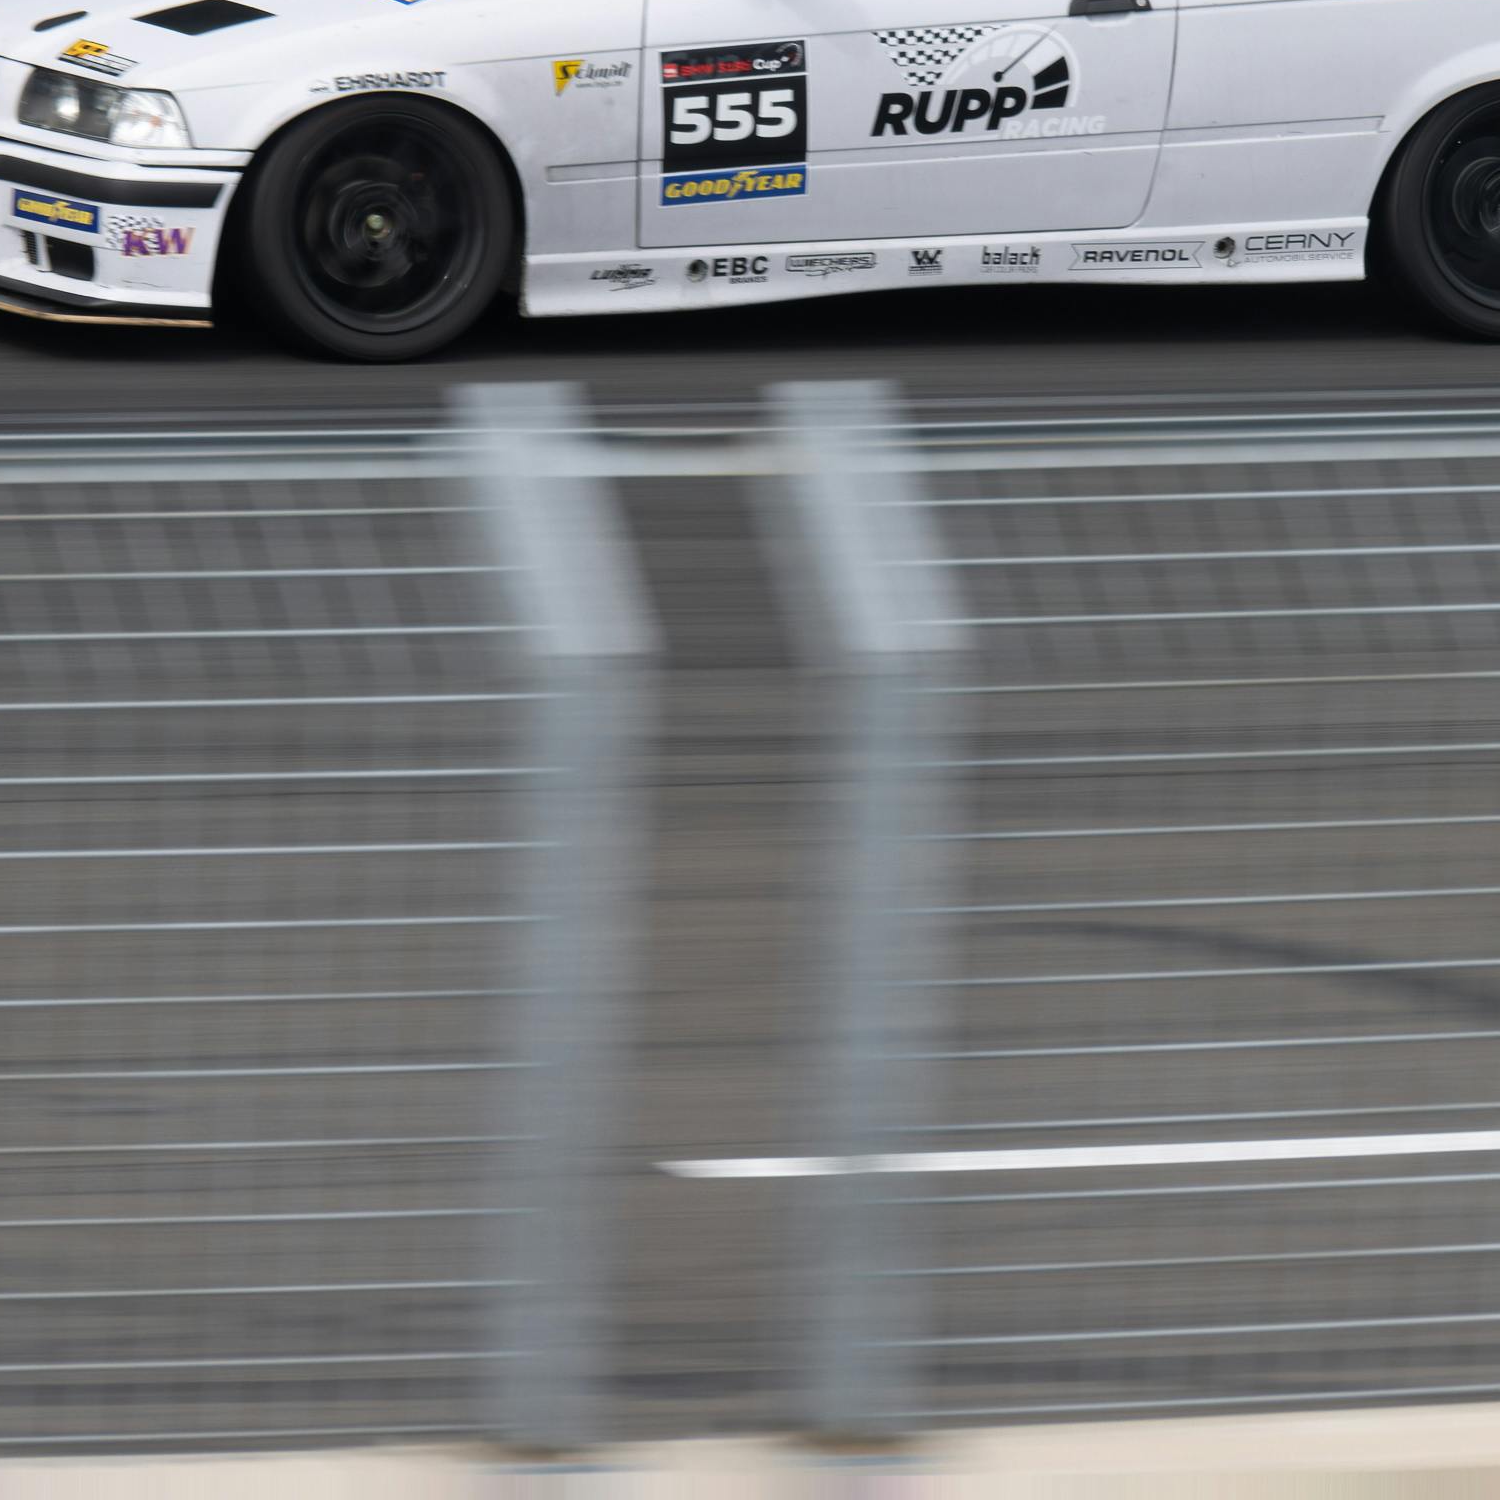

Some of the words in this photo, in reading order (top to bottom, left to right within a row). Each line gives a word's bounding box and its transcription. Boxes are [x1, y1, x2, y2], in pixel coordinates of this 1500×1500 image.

[753, 58, 781, 72] Cup
[335, 71, 447, 92] EHRHARDT
[670, 89, 797, 145] 555
[870, 86, 1027, 137] RUPP
[1002, 115, 1107, 140] RACING
[665, 170, 804, 198] GOODYEAR
[122, 227, 197, 258] KW
[1245, 232, 1356, 251] CERNY
[1083, 248, 1190, 263] RAVENOL
[1244, 252, 1355, 264] AUTOMOBILSERVICE
[713, 256, 768, 277] EBC
